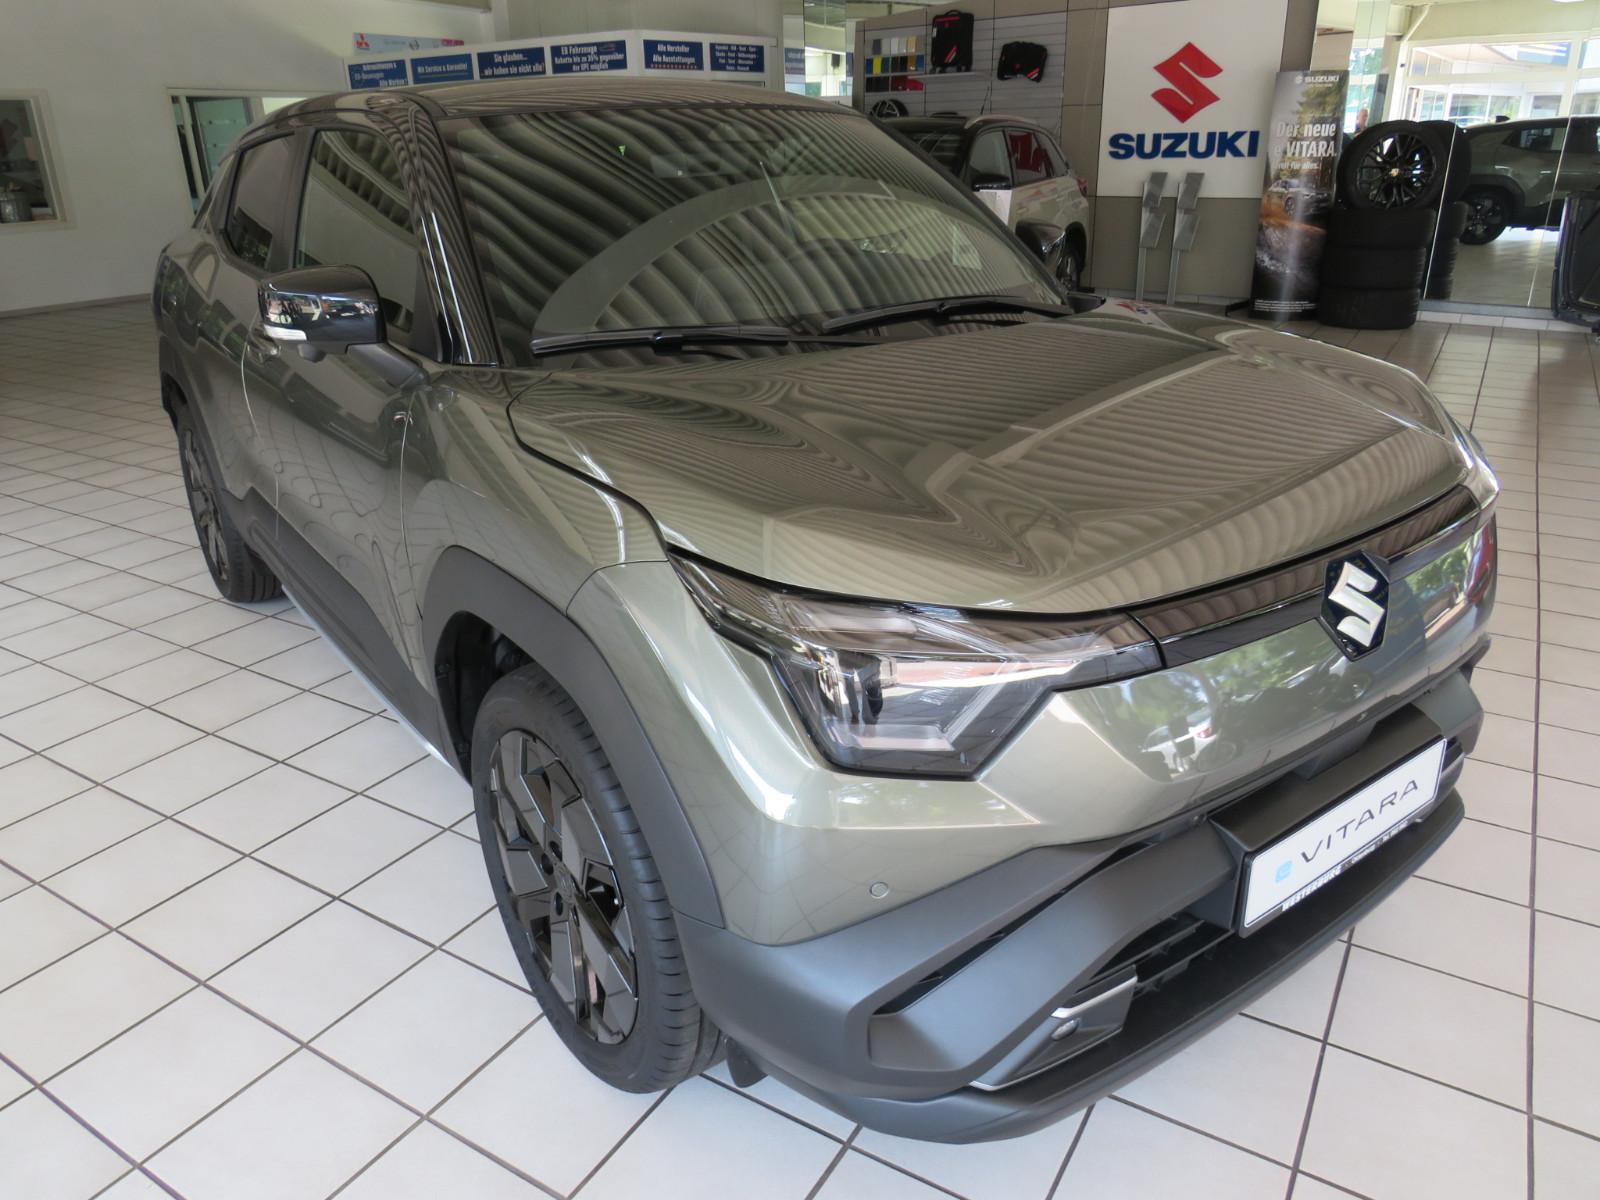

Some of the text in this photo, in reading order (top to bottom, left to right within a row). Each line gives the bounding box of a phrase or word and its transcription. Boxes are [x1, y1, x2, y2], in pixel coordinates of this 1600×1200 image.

[569, 45, 598, 54] Fahrzeuge
[494, 66, 509, 75] haben
[510, 66, 518, 74] sie
[519, 64, 532, 73] nicht
[1305, 75, 1339, 83] SUZUKI
[1277, 121, 1336, 137] Der neue
[1108, 131, 1260, 160] SUZUKI
[1286, 141, 1337, 157] VITARA.
[1301, 779, 1418, 863] VITARA
